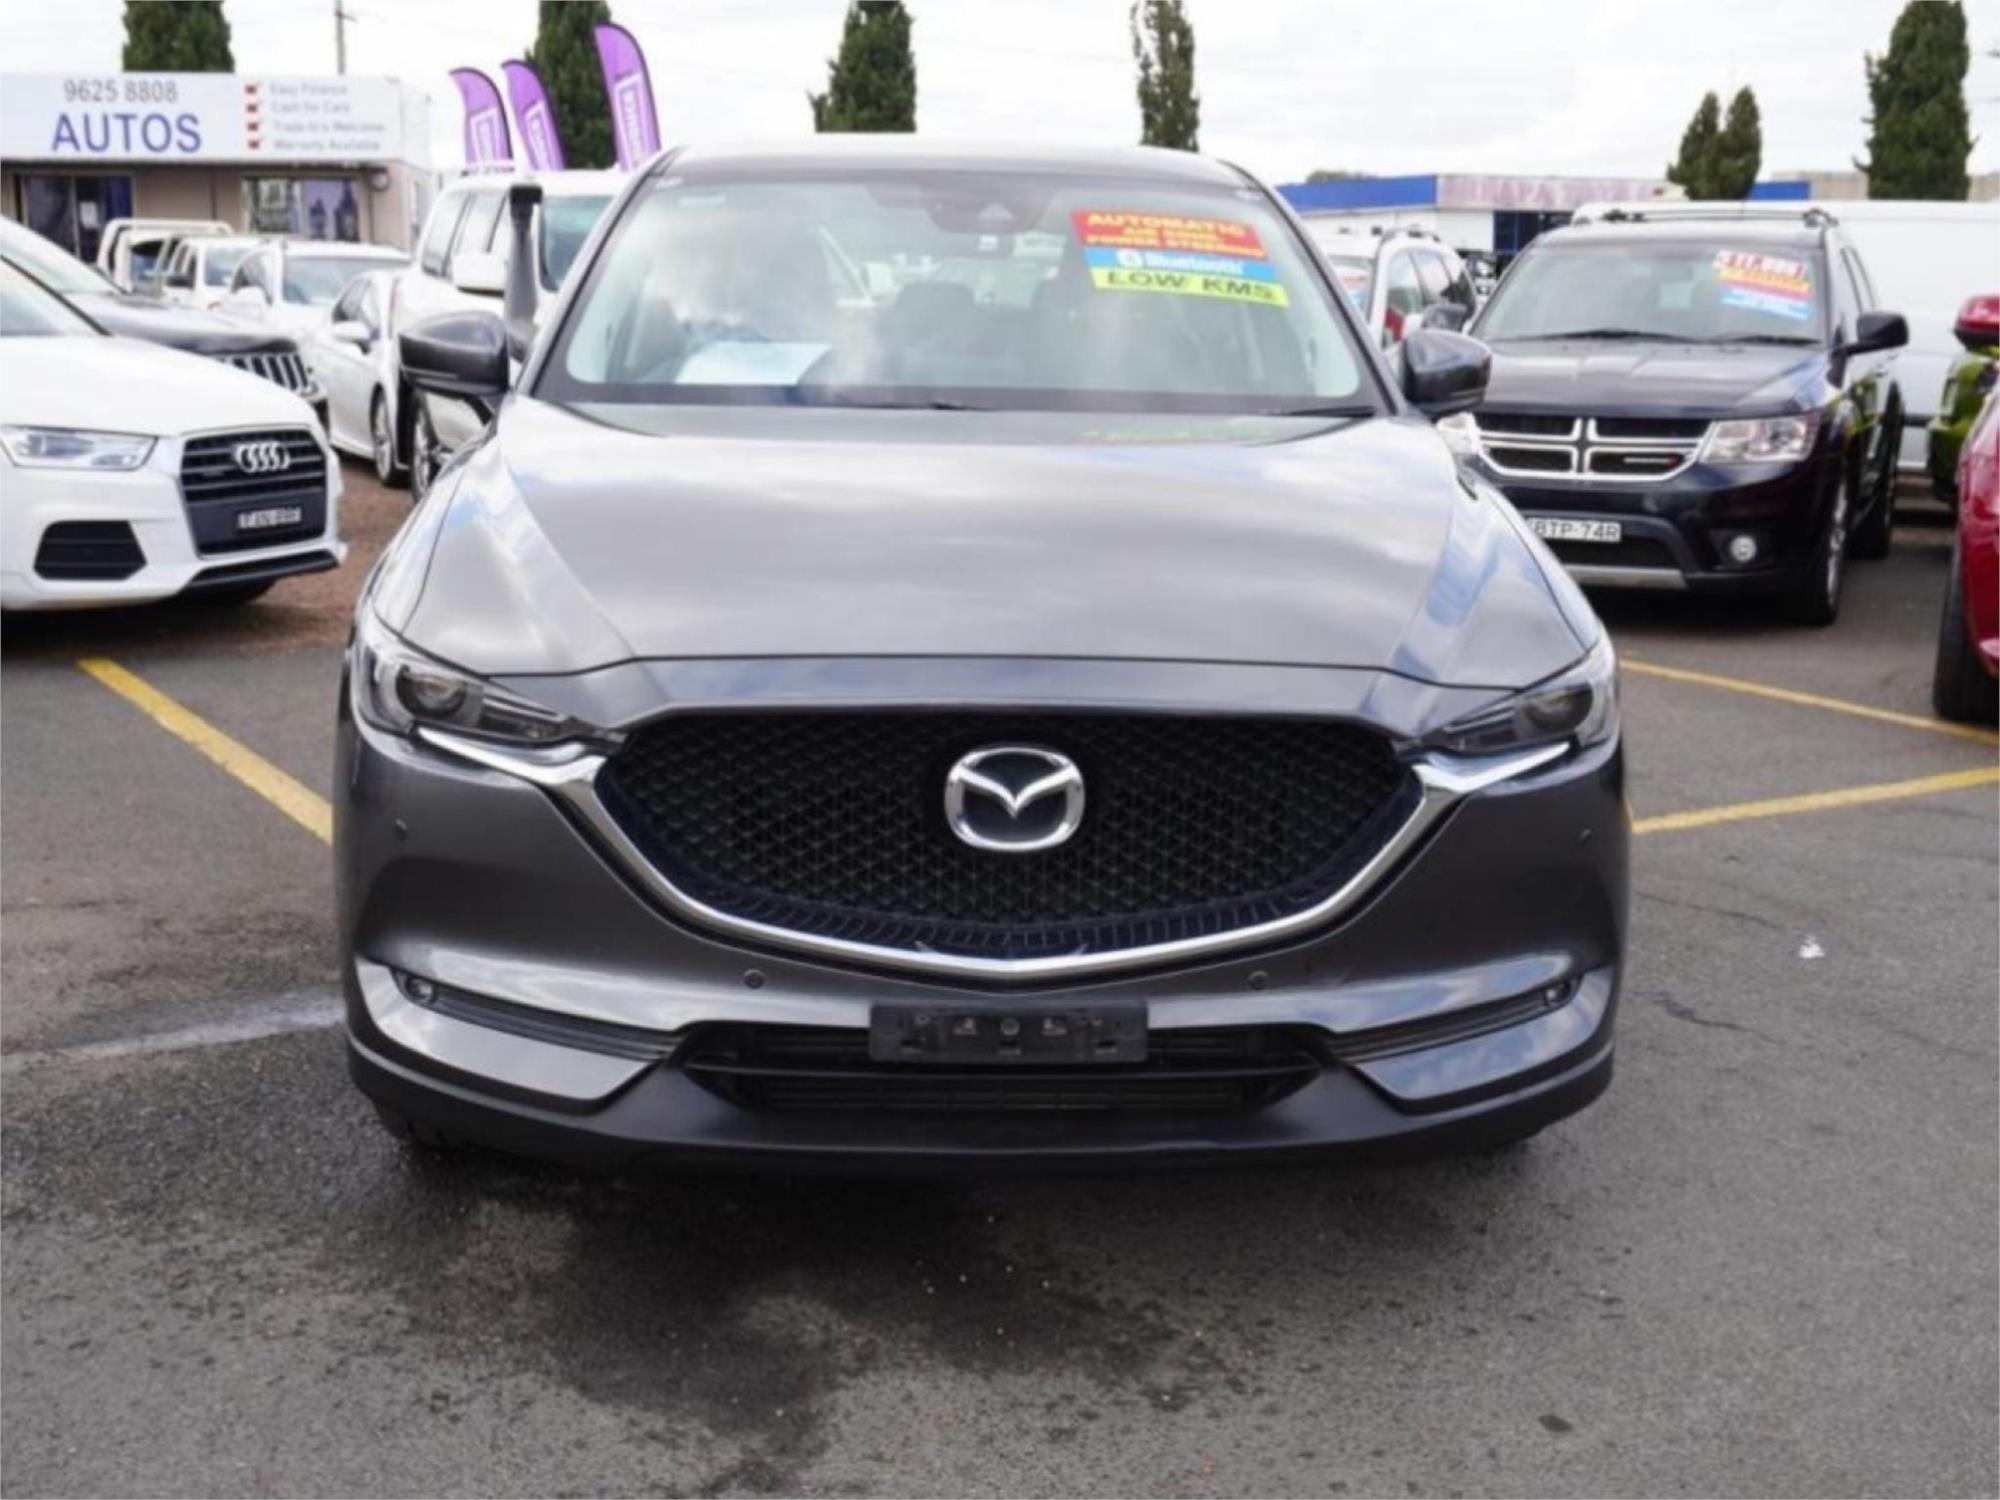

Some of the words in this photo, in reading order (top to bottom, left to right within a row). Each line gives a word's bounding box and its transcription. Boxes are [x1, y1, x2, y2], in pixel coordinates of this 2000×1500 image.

[63, 79, 118, 102] 9625
[125, 80, 178, 102] 8808
[52, 113, 202, 152] AUTOS
[1107, 270, 1186, 288] LOW
[1201, 277, 1273, 299] KMS
